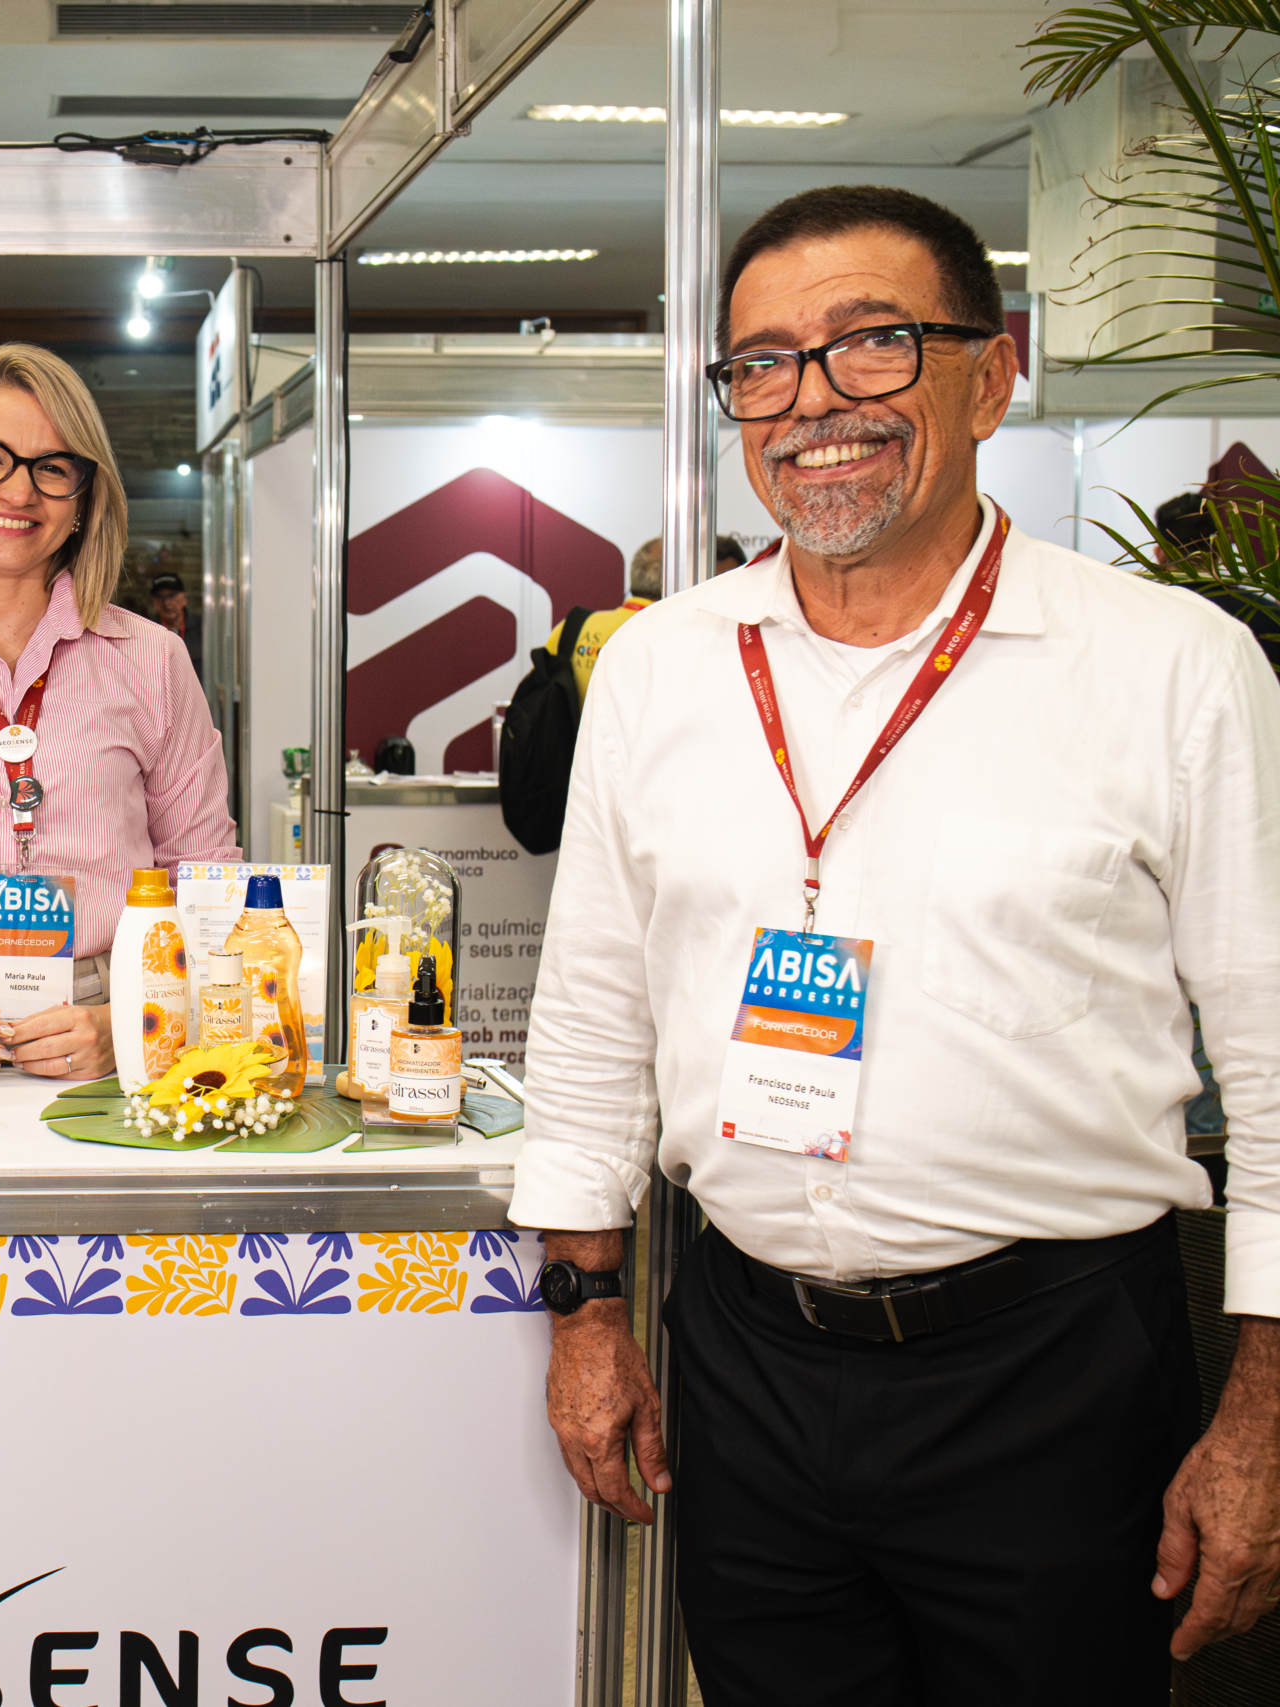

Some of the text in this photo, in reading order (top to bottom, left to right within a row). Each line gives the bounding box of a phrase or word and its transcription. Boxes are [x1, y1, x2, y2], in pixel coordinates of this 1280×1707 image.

[729, 530, 777, 549] Pern
[742, 624, 753, 645] ENSE
[944, 610, 975, 654] NEOSENSE
[423, 846, 519, 861] rnambuco
[469, 943, 514, 958] seus
[5, 972, 46, 982] Maria Paula
[752, 947, 862, 992] ABISA
[9, 984, 40, 992] NEOSENSE
[145, 986, 185, 999] Girassol
[748, 983, 860, 1009] NORDESTE
[203, 1015, 241, 1025] Girassol
[459, 1005, 486, 1023] ão,
[500, 1029, 527, 1043] me
[753, 1018, 838, 1041] FORNECEDOR
[359, 1043, 390, 1055] Girassol
[397, 1059, 441, 1067] AROMATIZADOR
[391, 1081, 450, 1100] Girassol
[748, 1073, 836, 1099] Francisco de Paula
[767, 1094, 811, 1110] NEOSENSE
